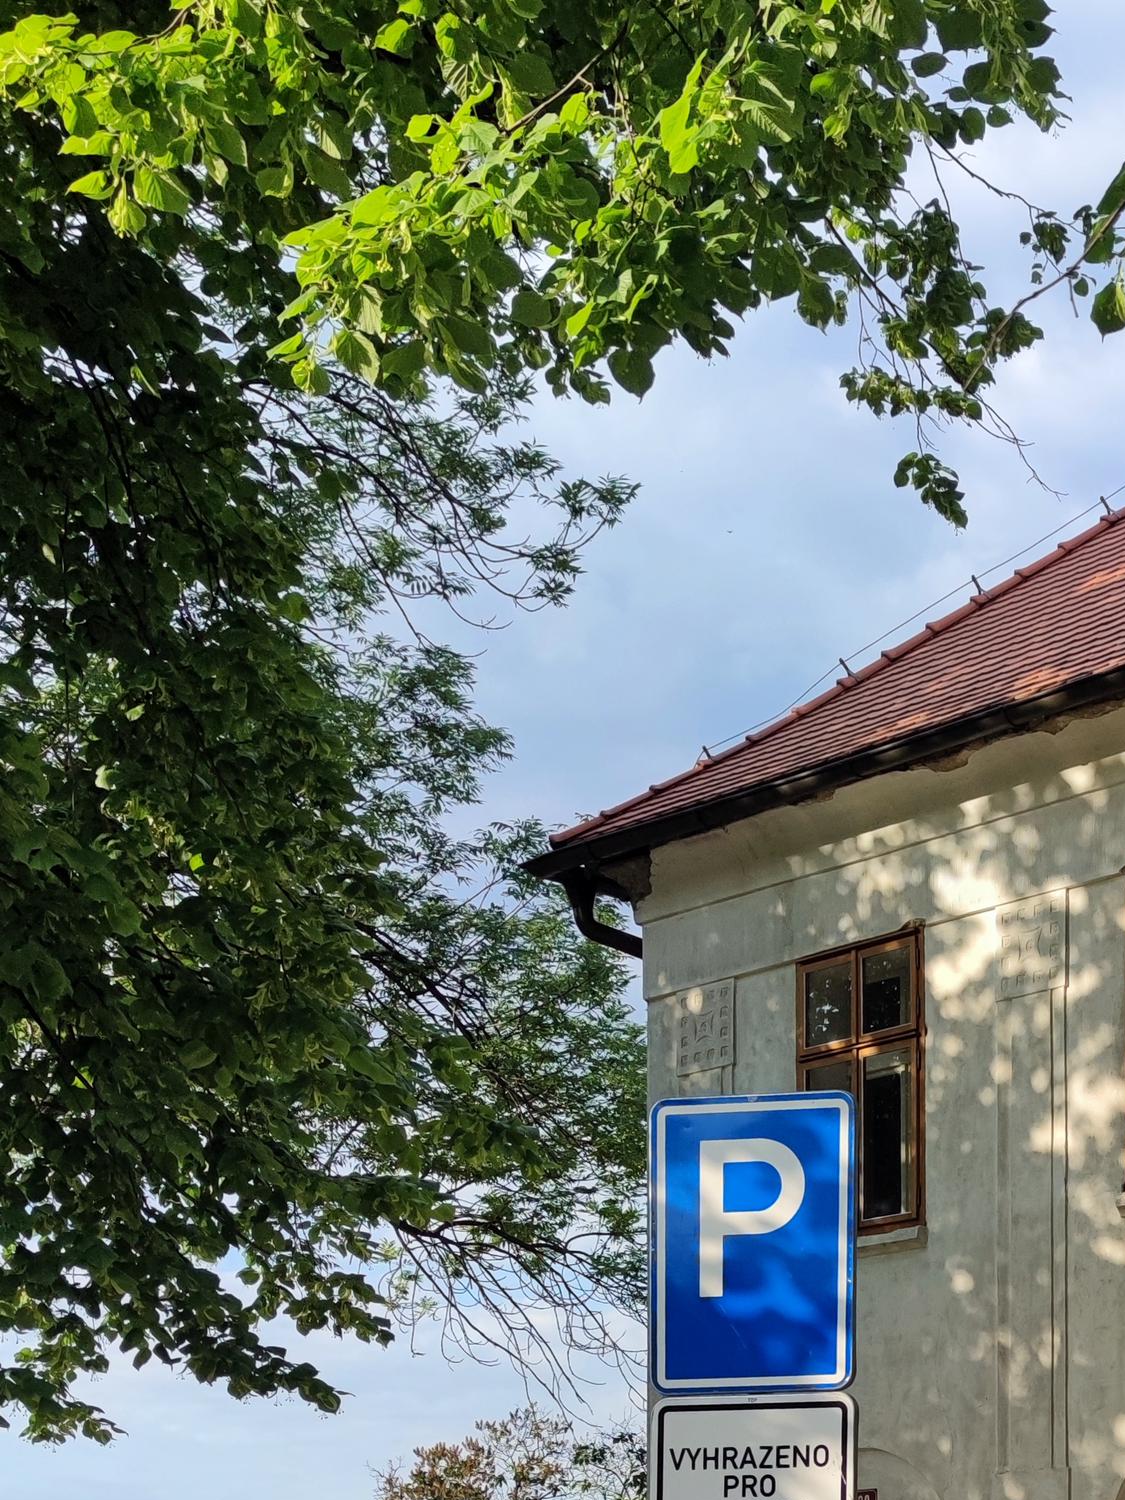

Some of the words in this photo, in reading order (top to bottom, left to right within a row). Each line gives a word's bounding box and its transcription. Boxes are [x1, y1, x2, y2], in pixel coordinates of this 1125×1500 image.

[699, 1138, 805, 1297] P
[669, 1444, 829, 1471] VYHRAZENO
[723, 1473, 776, 1498] PRO
